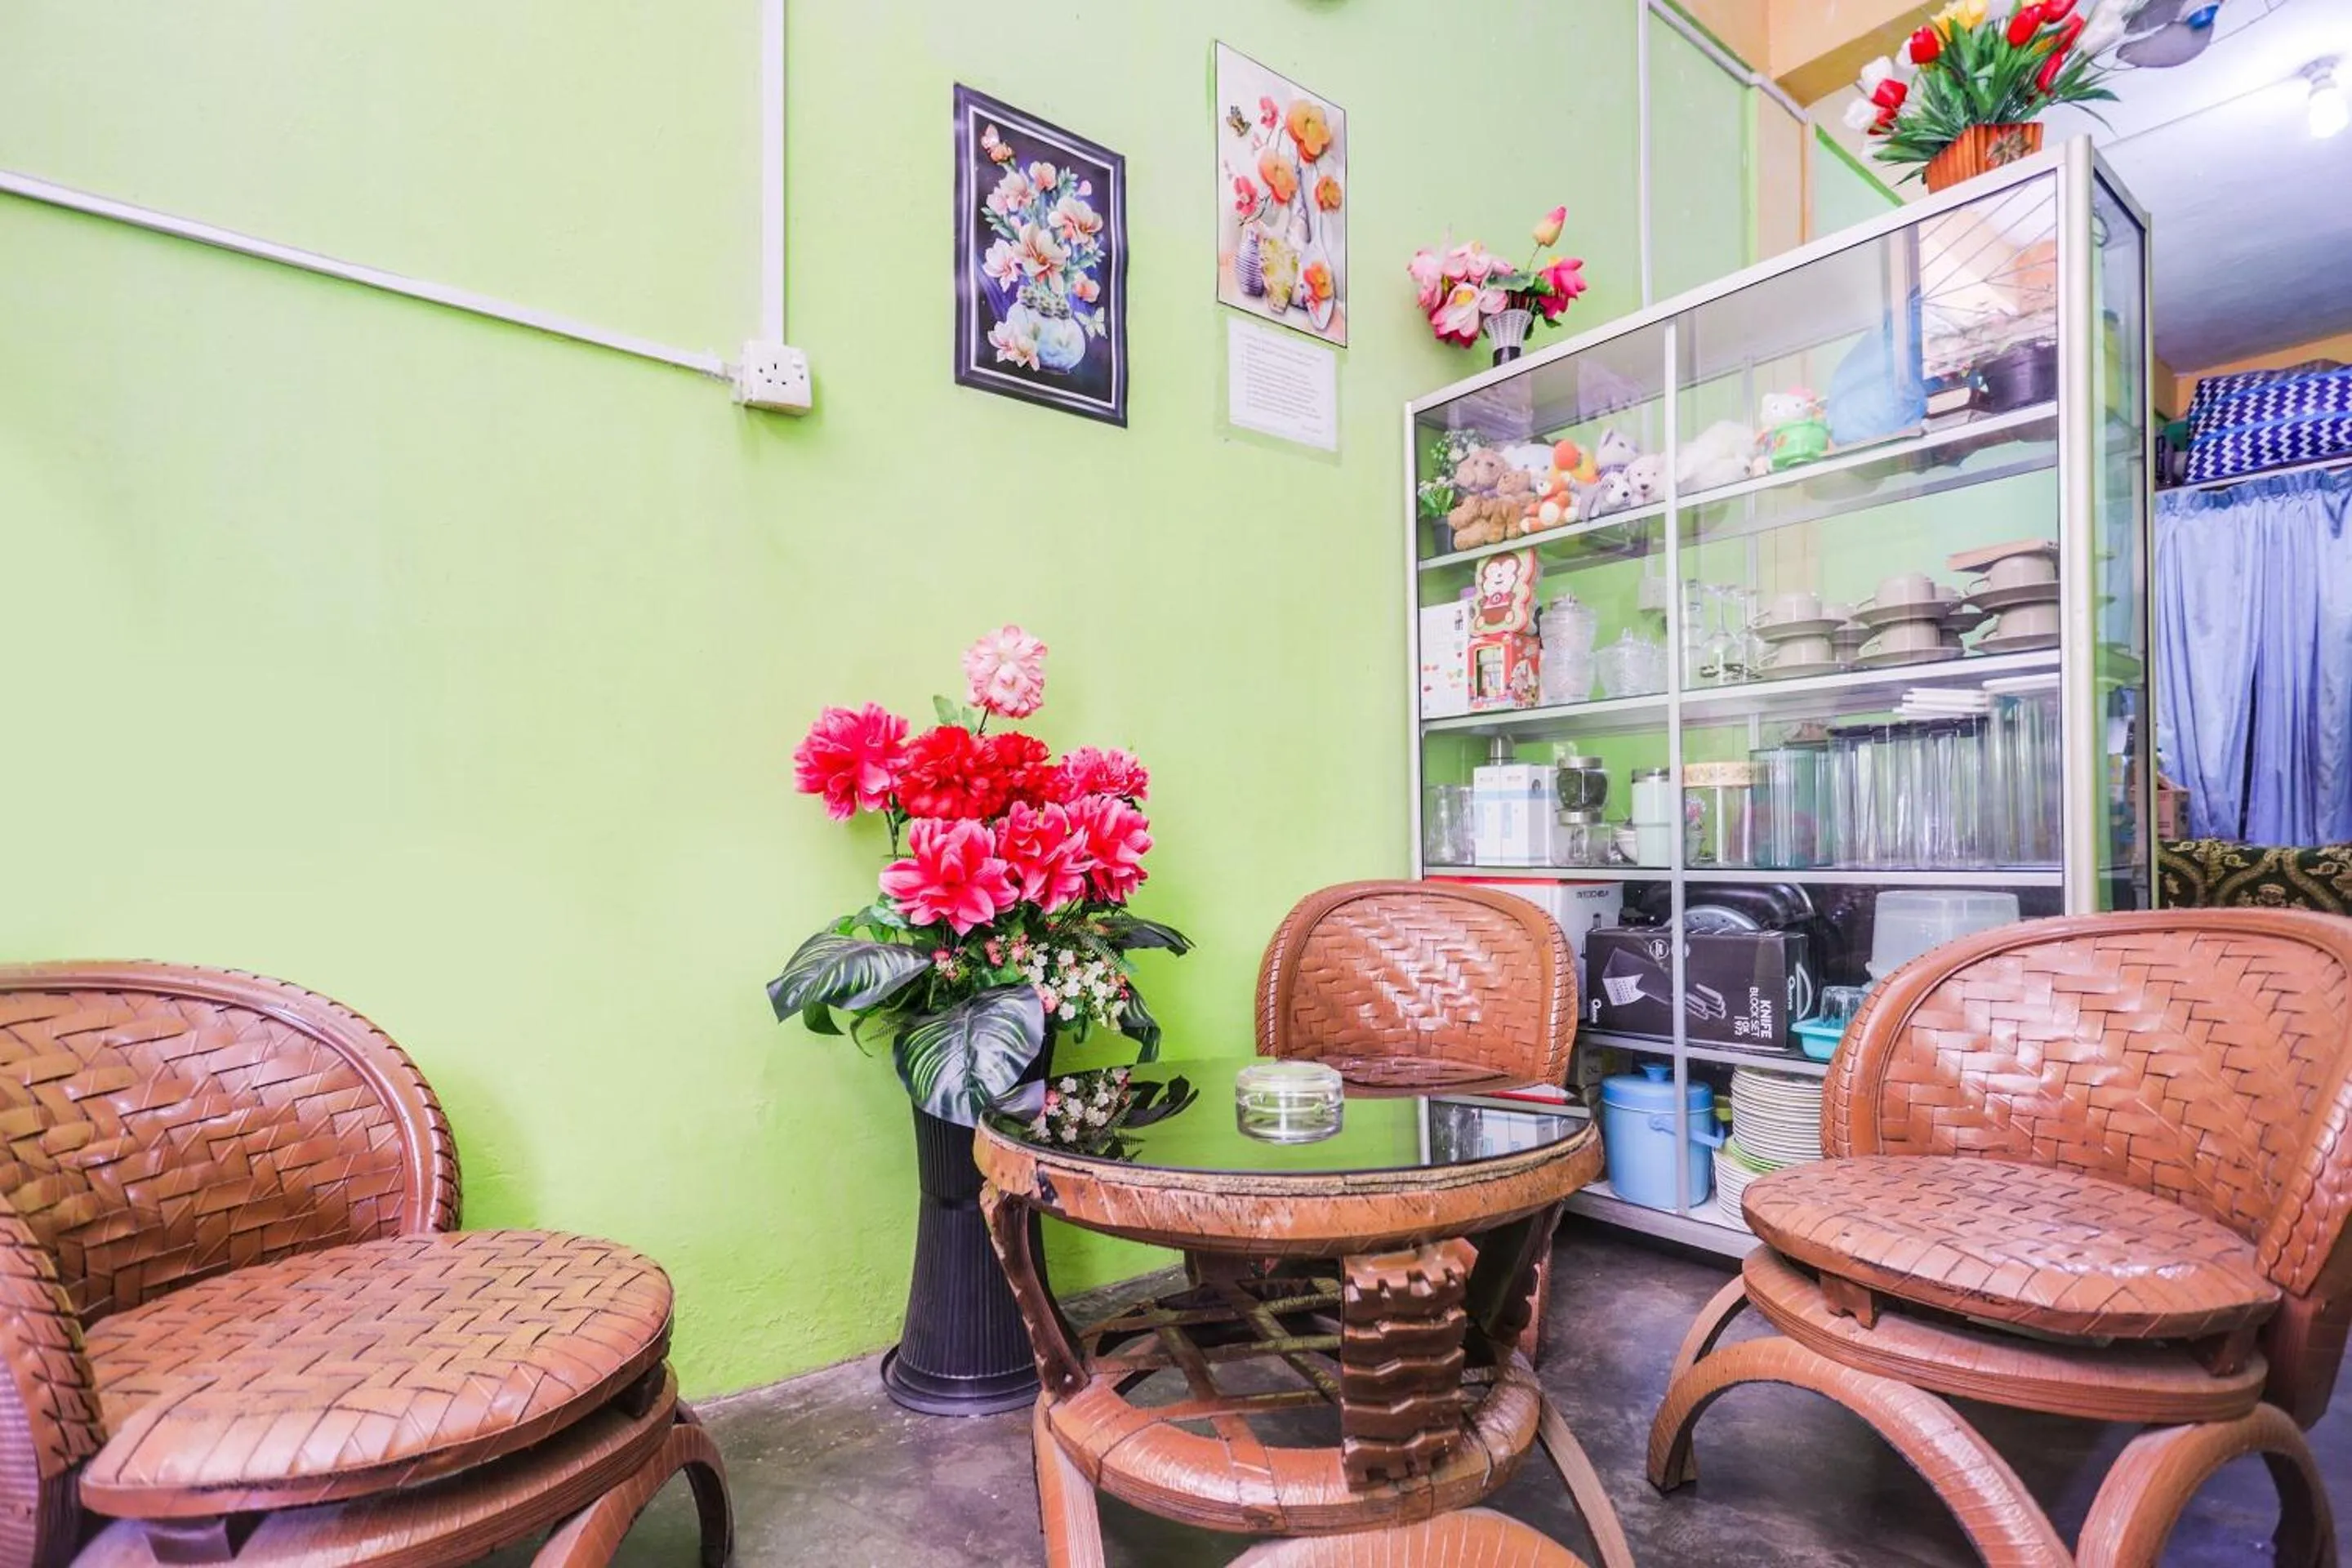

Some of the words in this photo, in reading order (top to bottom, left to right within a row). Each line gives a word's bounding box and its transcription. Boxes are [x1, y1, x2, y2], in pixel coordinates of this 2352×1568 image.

[1749, 987, 1758, 1018] BLOCK
[1751, 1019, 1760, 1037] SET
[1760, 1000, 1772, 1039] KNIFE
